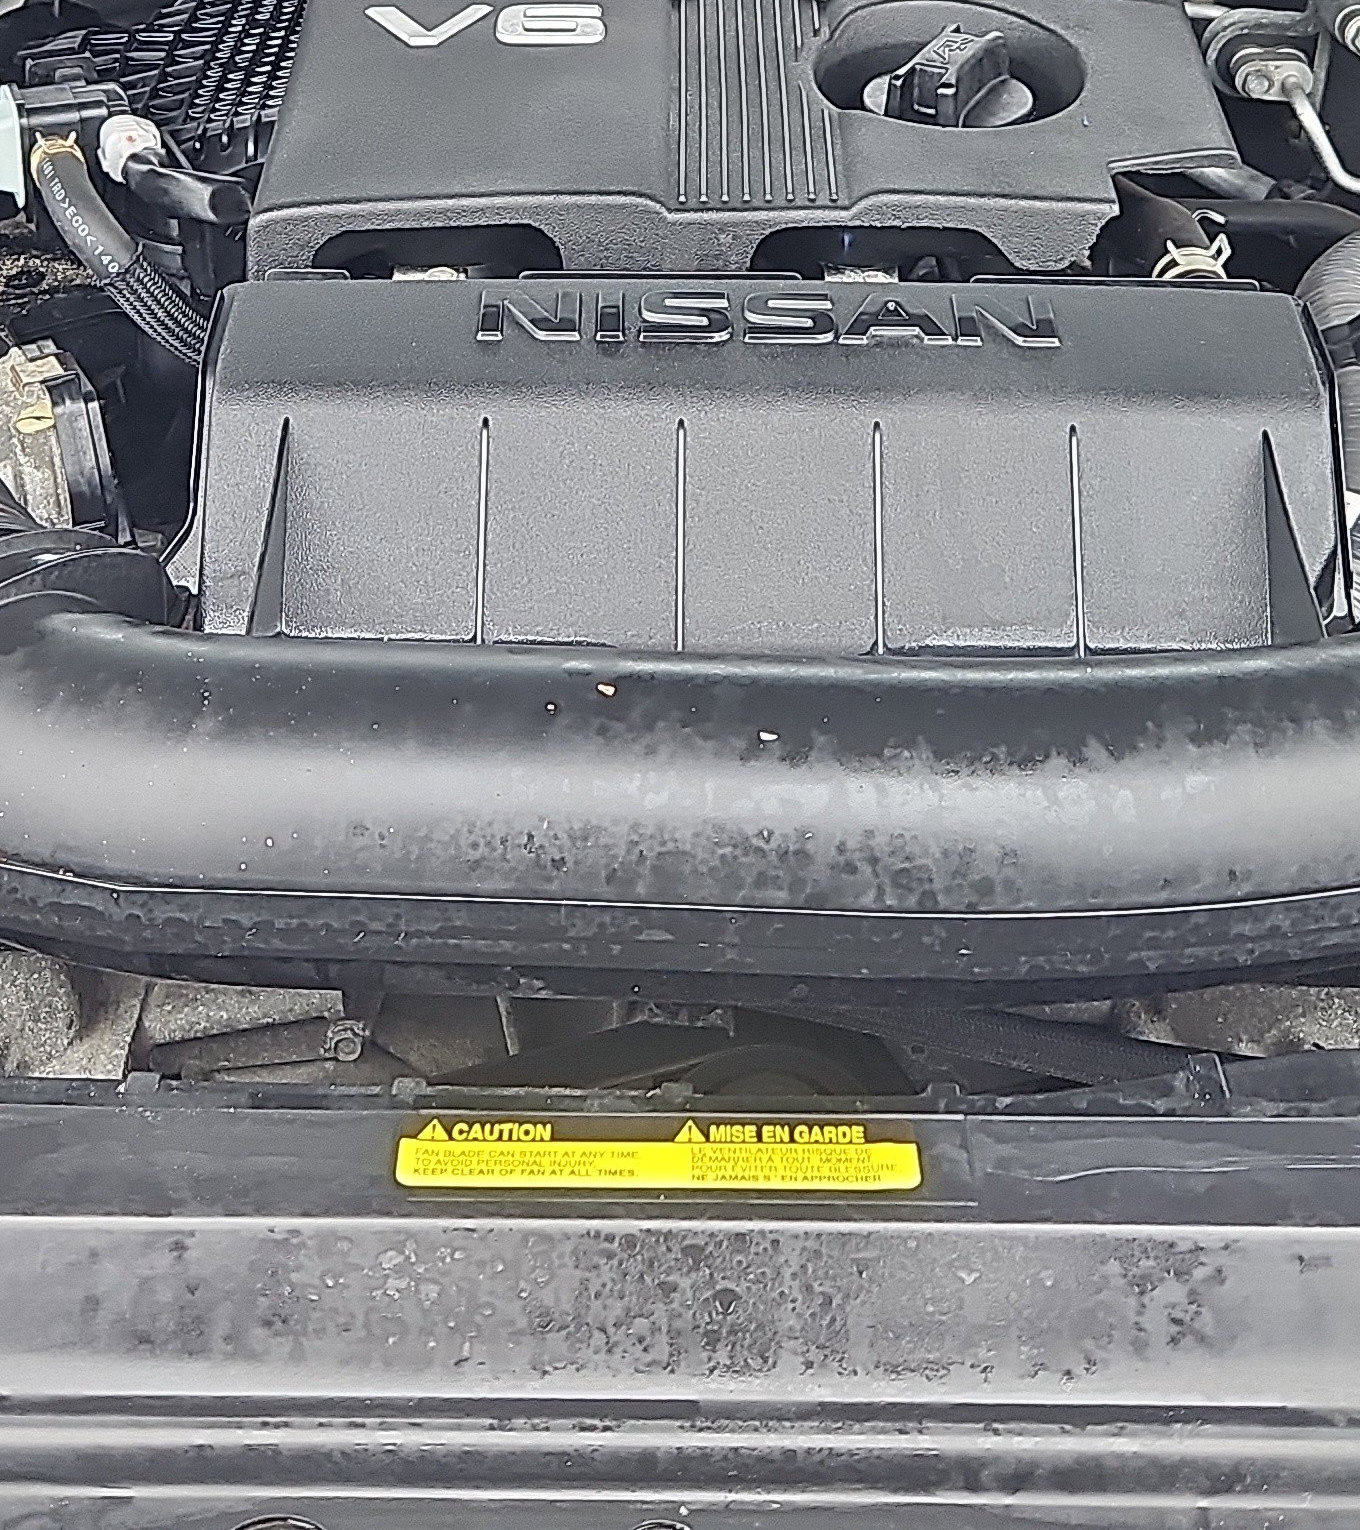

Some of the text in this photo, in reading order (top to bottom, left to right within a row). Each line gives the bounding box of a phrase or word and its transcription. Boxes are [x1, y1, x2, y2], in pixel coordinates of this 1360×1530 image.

[364, 3, 607, 47] V6
[476, 290, 1061, 347] NISSAN
[452, 1123, 552, 1141] CAUTION
[709, 1124, 866, 1143] MISE EN GARDE
[415, 1148, 439, 1157] FAN
[444, 1149, 484, 1158] BLADE
[488, 1150, 515, 1158] CAN
[519, 1150, 558, 1158] START
[561, 1150, 577, 1158] AT
[580, 1151, 606, 1159] ANY
[691, 1147, 872, 1156] LE VENTILATEUR RISQUE DE
[415, 1157, 431, 1166] TO
[434, 1158, 473, 1167] AVOID
[476, 1159, 545, 1167] PERSONAL
[779, 1156, 812, 1164] TOUT
[413, 1168, 448, 1176] KEEP
[452, 1168, 495, 1176] CLEAR
[499, 1168, 516, 1176] OF
[520, 1168, 545, 1176] FAN
[549, 1168, 564, 1176] AT
[569, 1168, 592, 1176] ALL
[691, 1165, 723, 1173] POUR
[691, 1174, 710, 1182] NE
[712, 1174, 759, 1182] JAMAIS
[802, 1174, 882, 1183] APPROCHER
